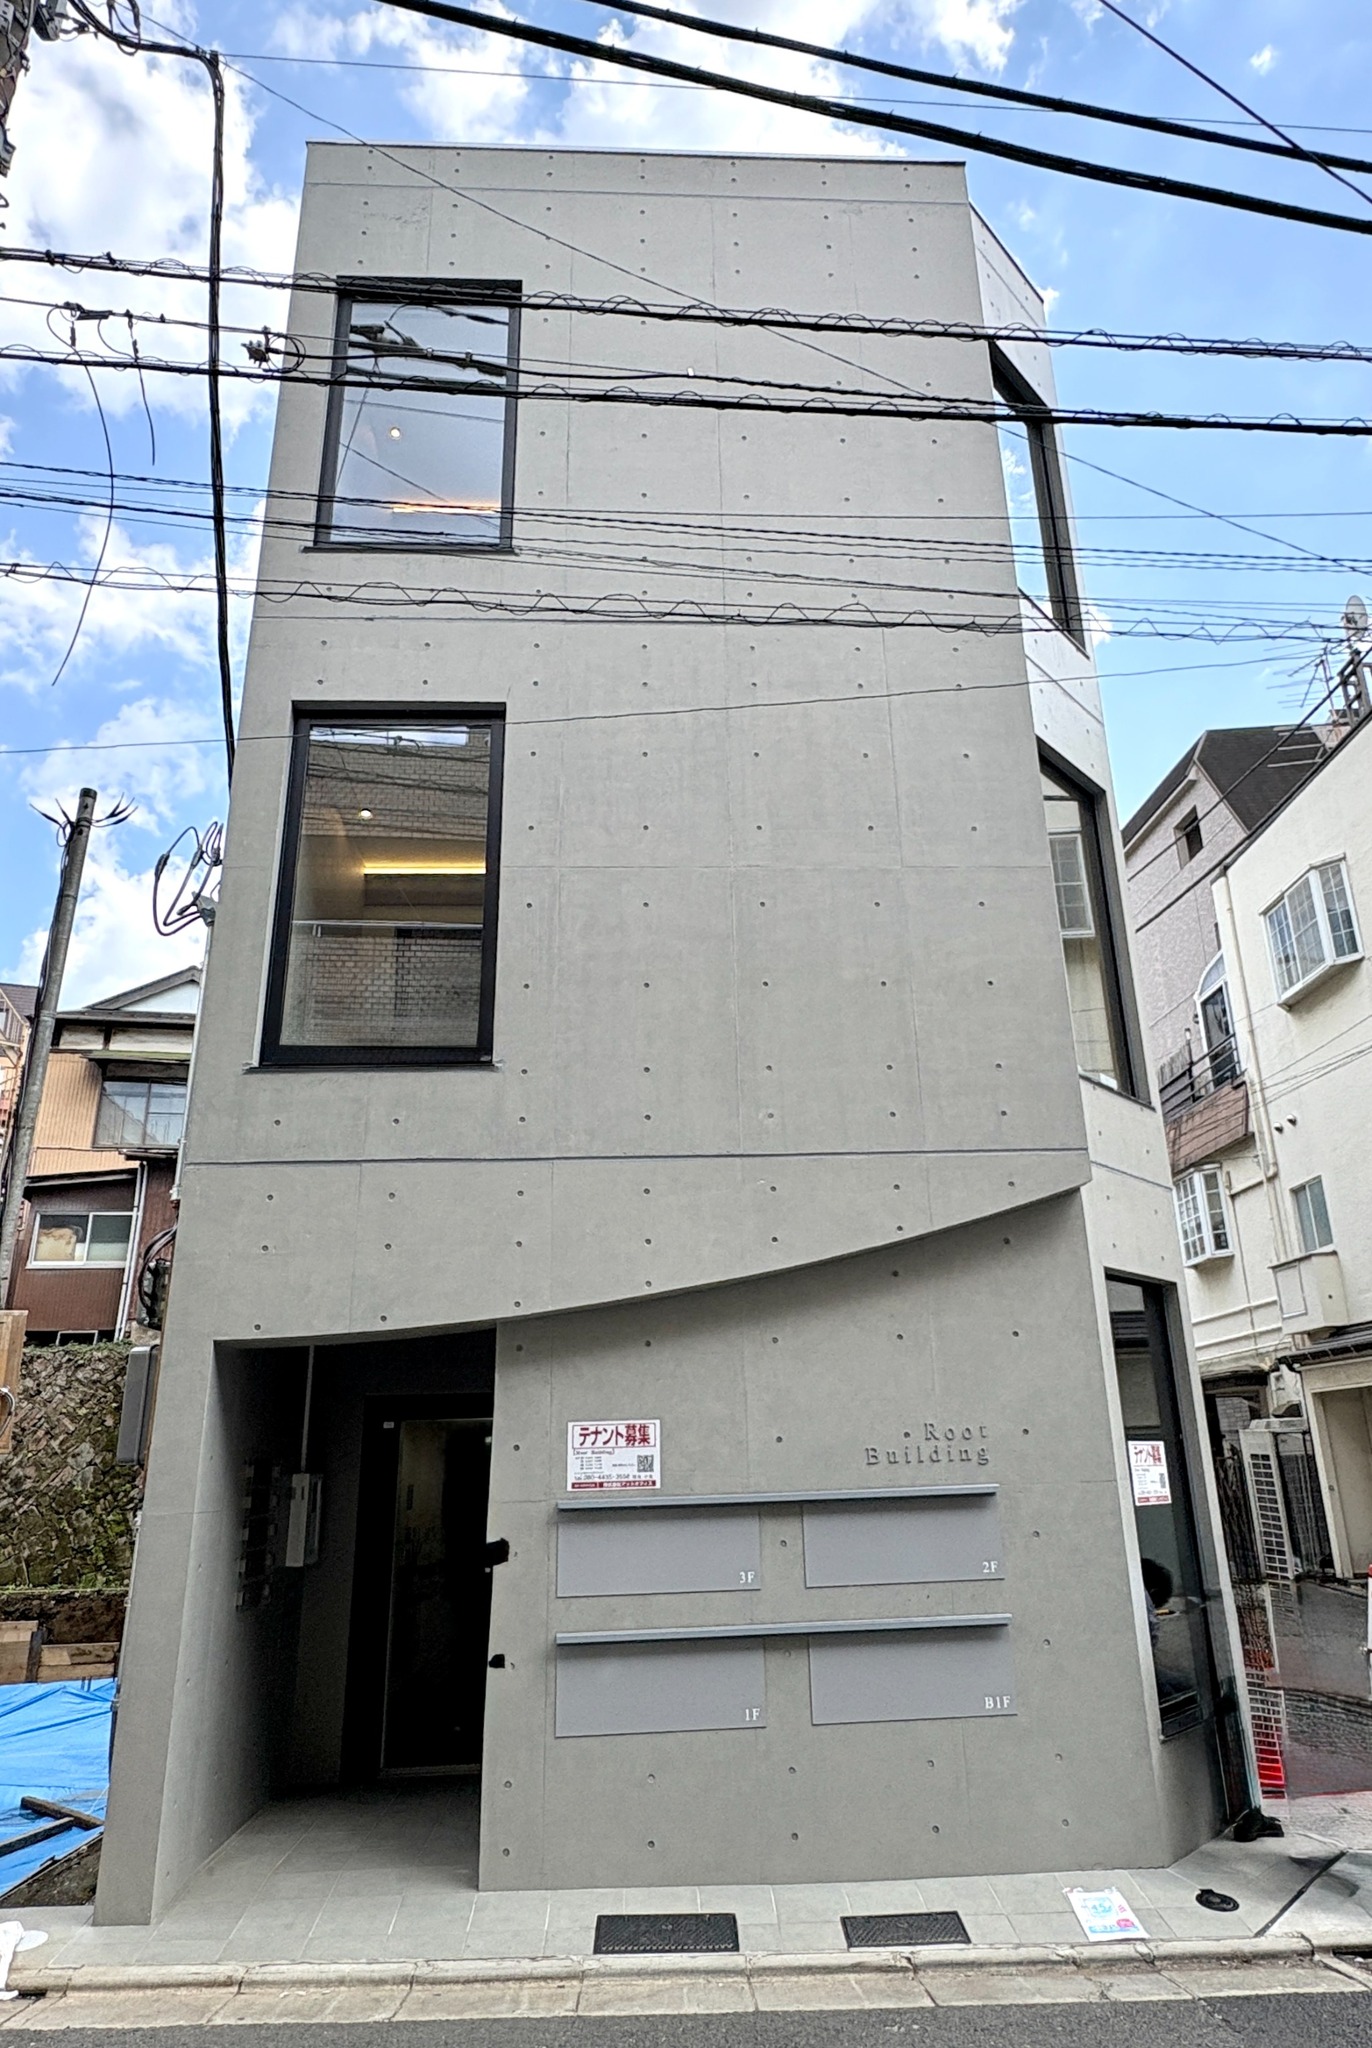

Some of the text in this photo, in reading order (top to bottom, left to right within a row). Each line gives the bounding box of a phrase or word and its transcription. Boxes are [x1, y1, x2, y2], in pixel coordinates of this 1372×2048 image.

[578, 1423, 651, 1447] テナント募集
[924, 1422, 988, 1441] Root
[864, 1444, 990, 1466] Building
[982, 1561, 998, 1575] 2F
[739, 1571, 756, 1585] 3F
[984, 1696, 1011, 1710] B1F
[744, 1708, 761, 1722] 1F
